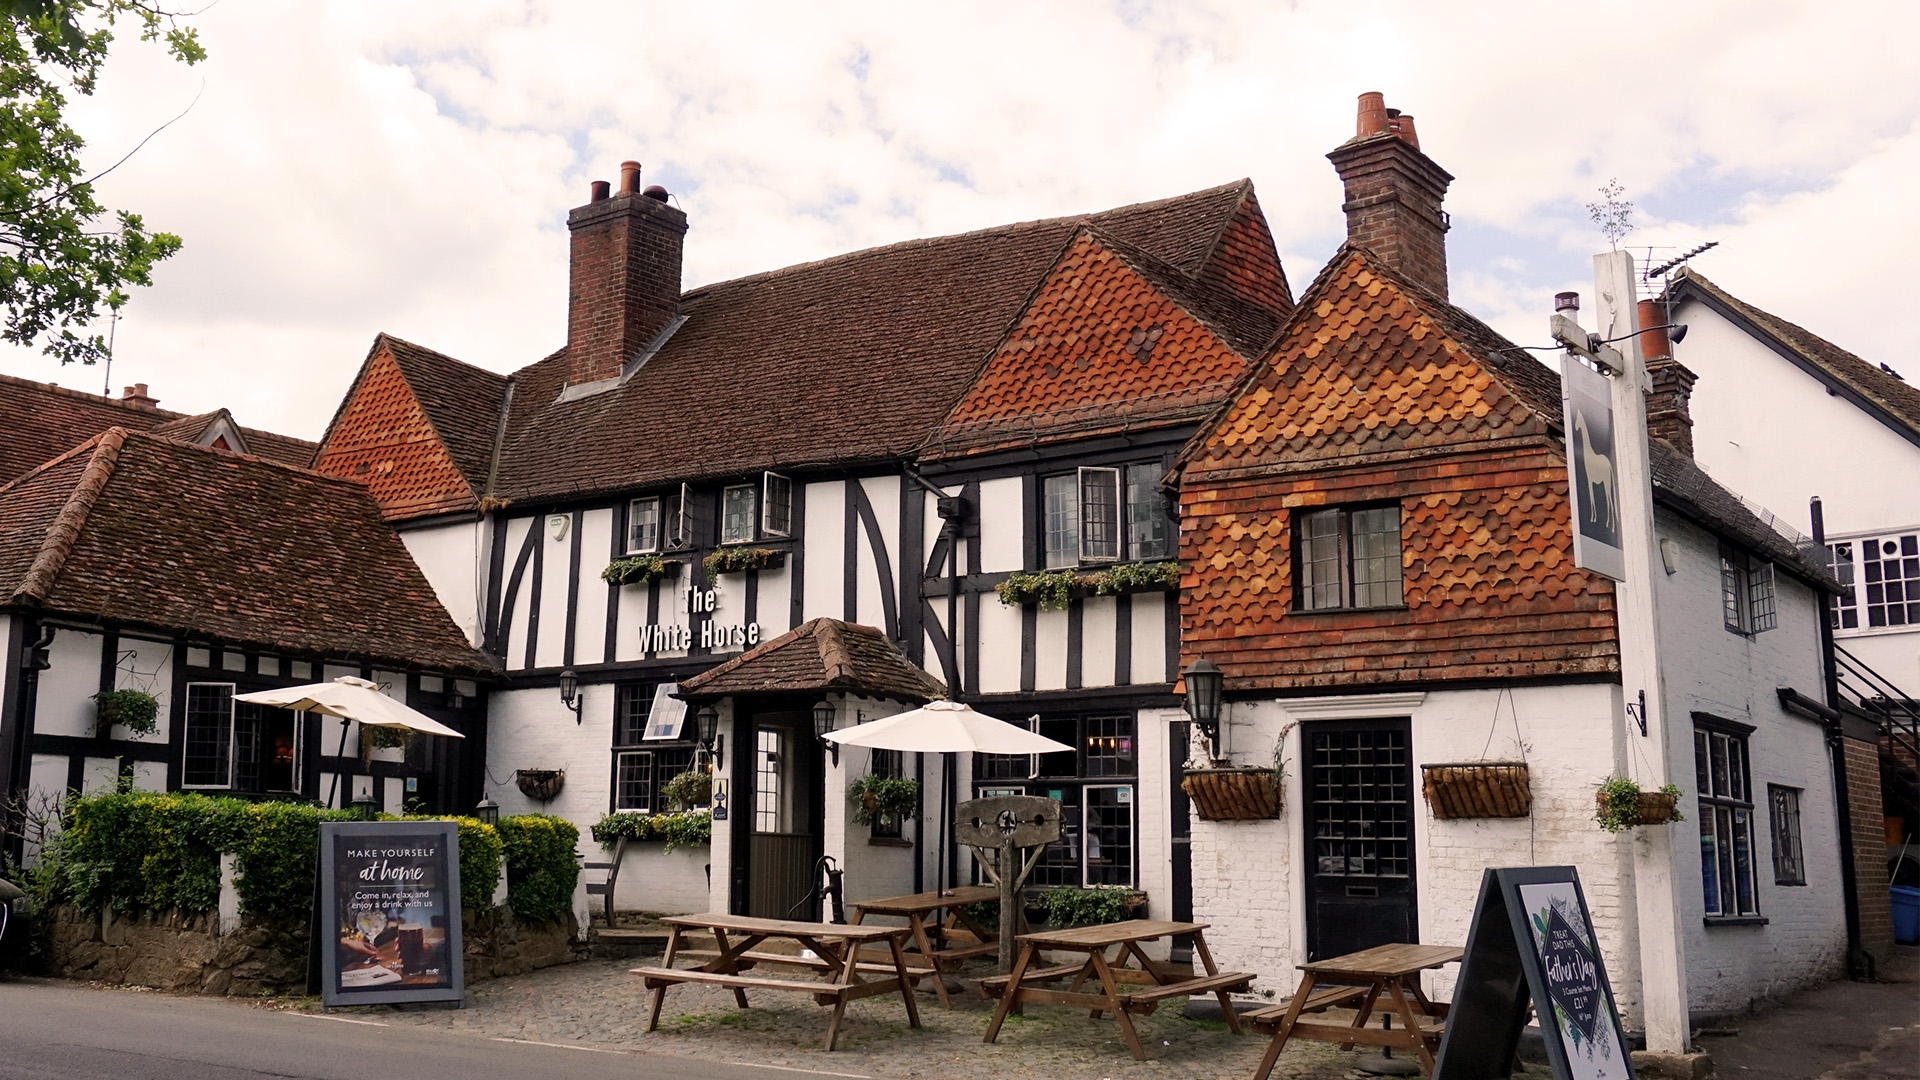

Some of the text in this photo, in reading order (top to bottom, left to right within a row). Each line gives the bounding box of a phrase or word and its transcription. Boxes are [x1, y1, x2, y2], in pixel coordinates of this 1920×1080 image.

[683, 585, 715, 614] The
[638, 619, 759, 653] White Horse
[347, 848, 435, 858] MAKE YOURSELF
[359, 859, 424, 881] at home
[354, 890, 430, 900] Come in, relax, and
[351, 902, 373, 911] enjoy
[381, 900, 403, 909] drink
[404, 900, 422, 909] with
[423, 900, 433, 908] us
[1552, 929, 1568, 940] TREAT
[1552, 939, 1576, 950] DAD THIS
[1544, 949, 1598, 990] Father's Day
